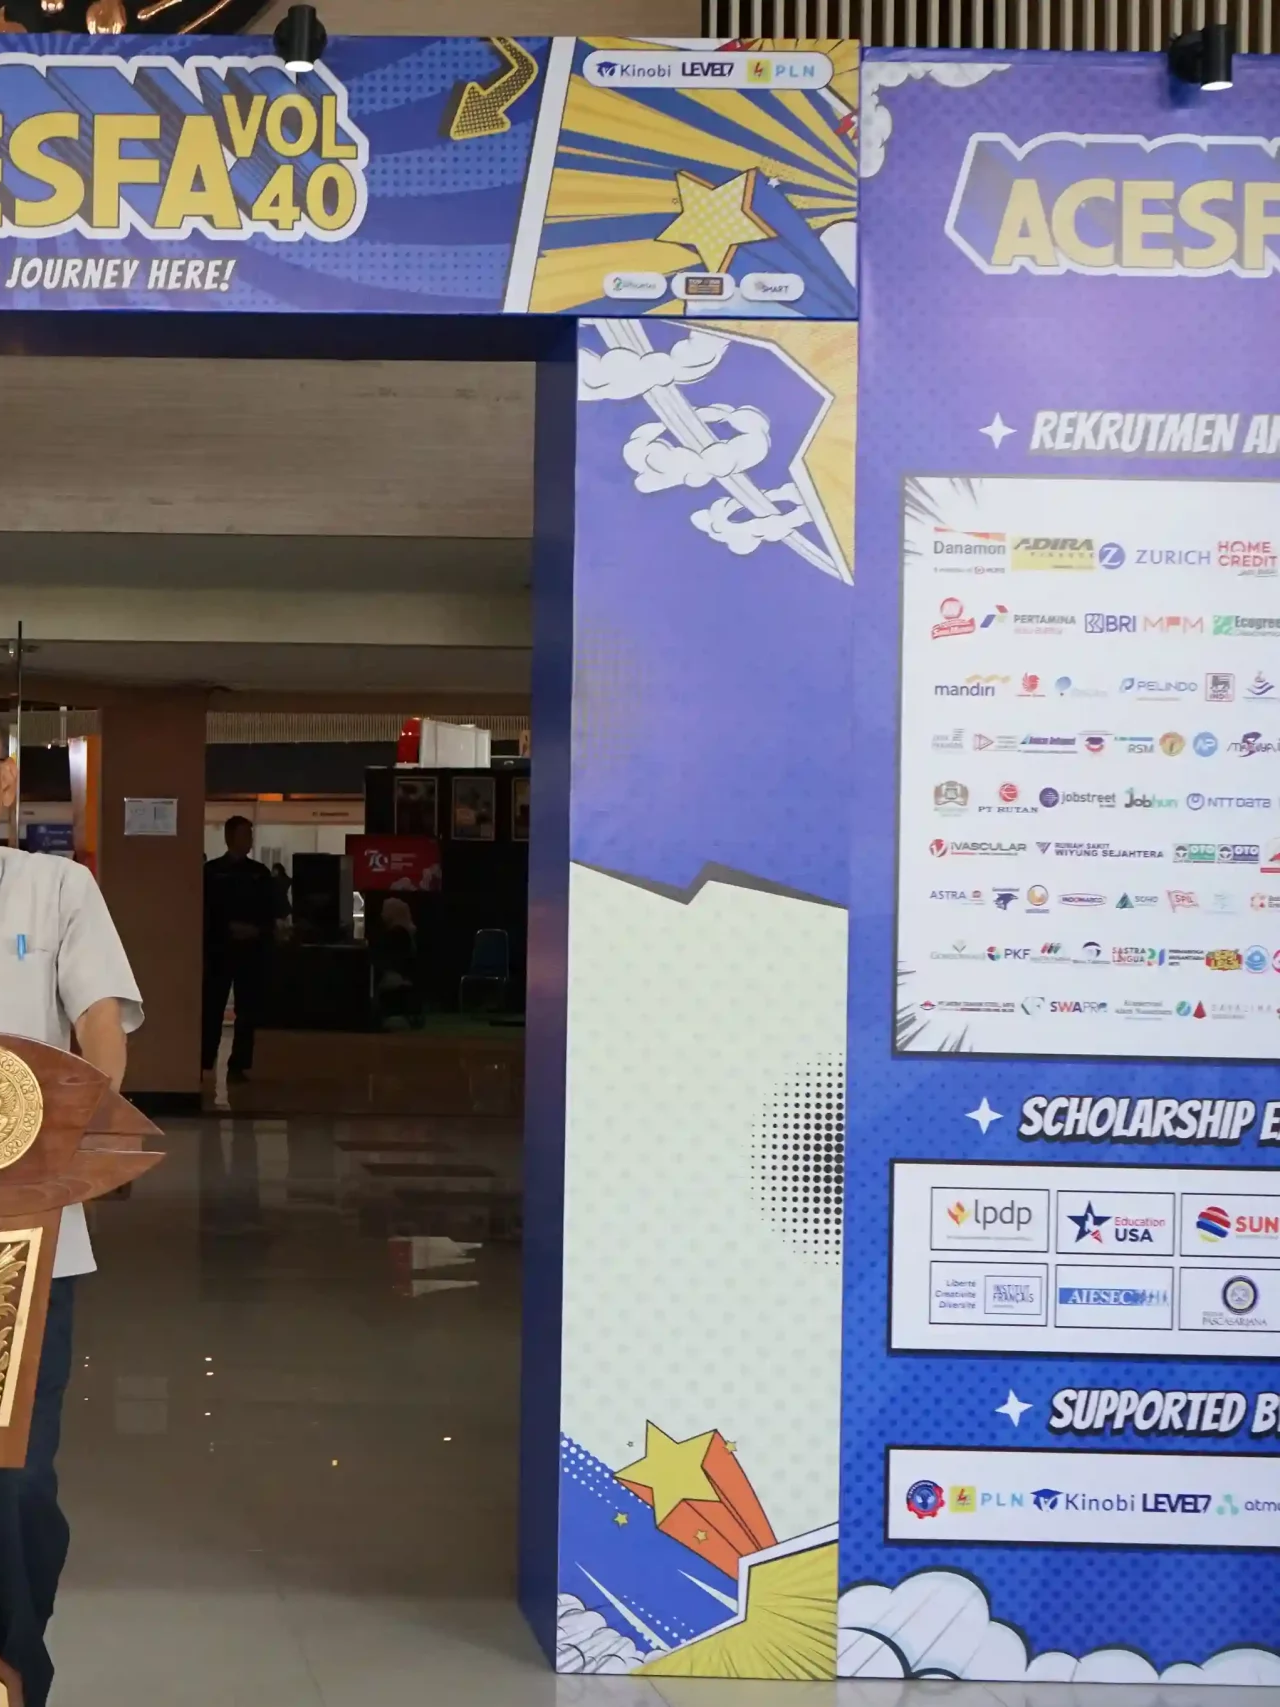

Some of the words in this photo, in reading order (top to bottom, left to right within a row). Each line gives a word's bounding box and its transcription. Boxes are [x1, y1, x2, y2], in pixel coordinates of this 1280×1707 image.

[620, 64, 671, 78] Kinobi
[775, 65, 815, 77] PLN
[221, 93, 358, 161] VOL
[250, 163, 358, 232] 40
[4, 256, 141, 291] JOURNEY
[147, 257, 237, 292] HERE!
[1029, 410, 1240, 453] REKRUTMEN
[933, 540, 1007, 555] Danamon
[1218, 540, 1271, 553] HOME
[1134, 549, 1211, 565] ZURICH
[1218, 554, 1278, 567] CREDIT
[1013, 614, 1077, 625] PERTAMINA
[1105, 614, 1137, 633] BRI
[1143, 616, 1204, 634] MPM
[1137, 681, 1198, 692] PELINDO
[1060, 791, 1117, 805] jobstreet
[996, 805, 1039, 813] RUTAN
[1055, 849, 1098, 857] WIYUNG
[1102, 850, 1164, 858] SEJAHTERA
[929, 890, 967, 900] ASTRA
[1004, 948, 1031, 960] PKF
[1019, 1096, 1256, 1140] SCHOLARSHIP
[974, 1199, 1032, 1232] lpdp
[1114, 1216, 1166, 1227] Education
[1114, 1228, 1154, 1243] USA
[1069, 1289, 1133, 1304] AIESEC
[1048, 1388, 1247, 1433] SUPPORTED
[980, 1492, 1024, 1507] PLN
[1065, 1493, 1135, 1512] Kinobi
